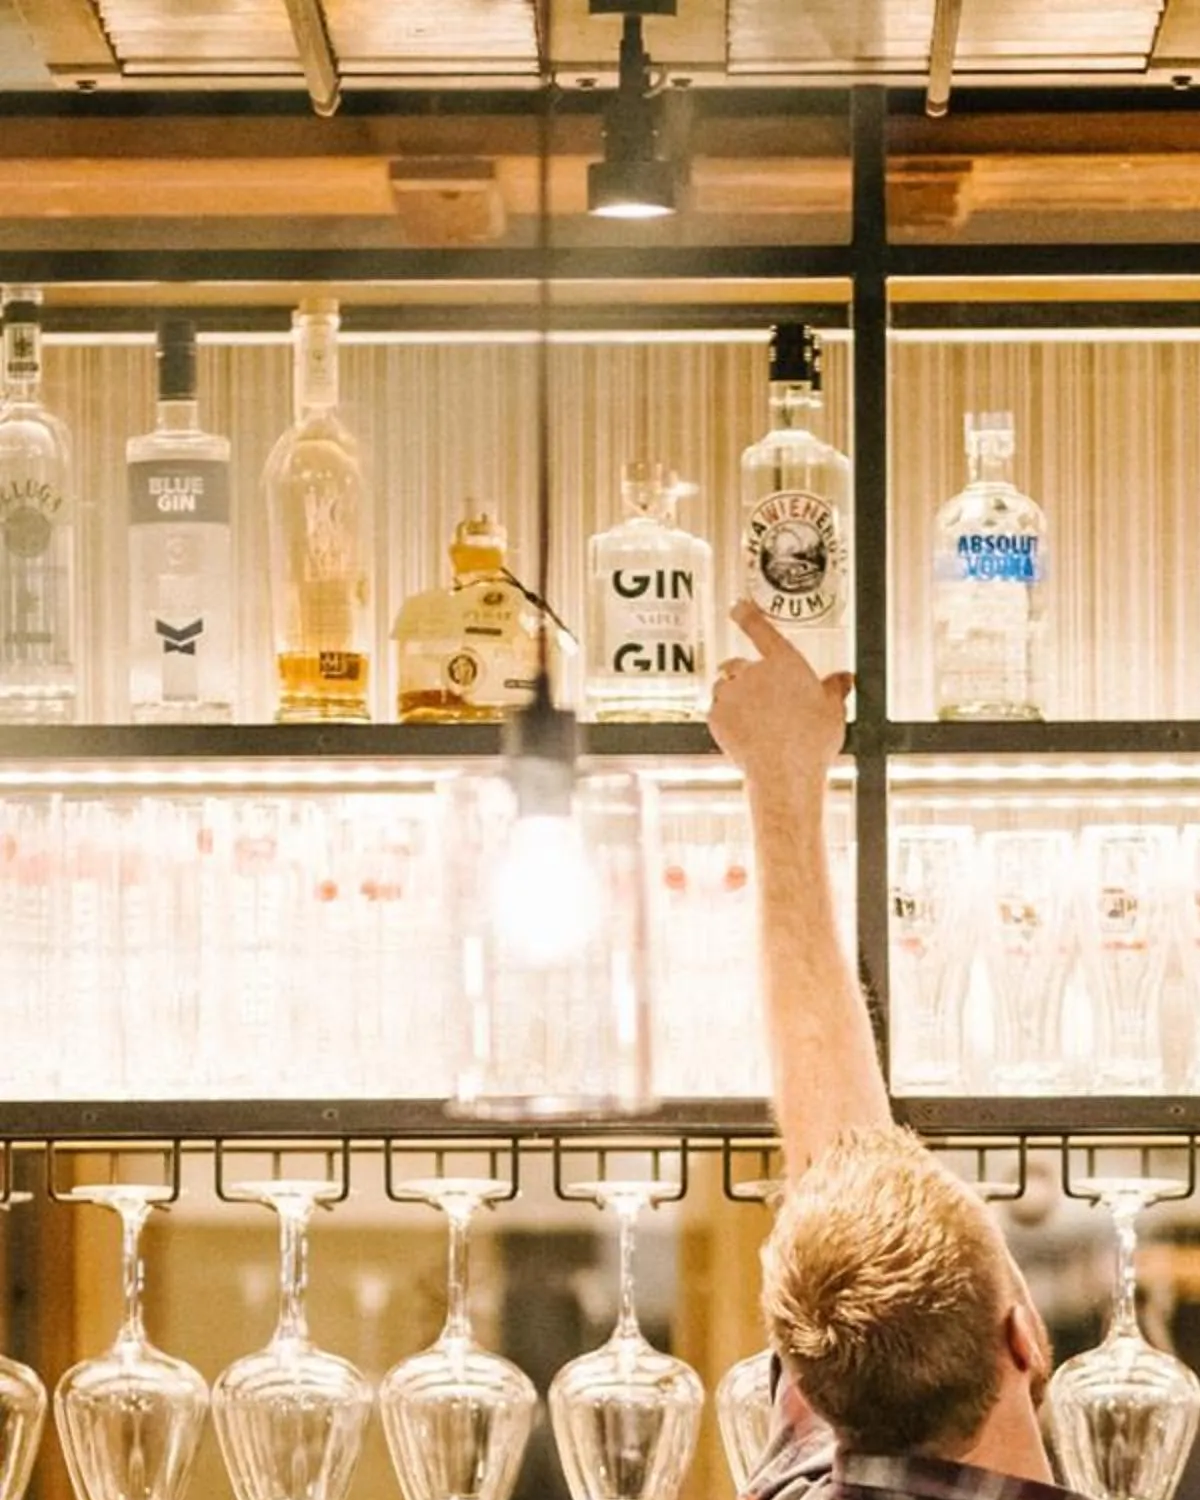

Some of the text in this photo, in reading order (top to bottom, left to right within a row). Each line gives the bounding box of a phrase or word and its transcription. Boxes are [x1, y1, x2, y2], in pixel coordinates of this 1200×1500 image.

[149, 477, 205, 494] BLUE
[156, 494, 196, 512] GIN
[958, 534, 1038, 554] ABSOLUT
[612, 569, 693, 599] GIN
[769, 593, 825, 617] RUM
[613, 642, 695, 673] GIN
